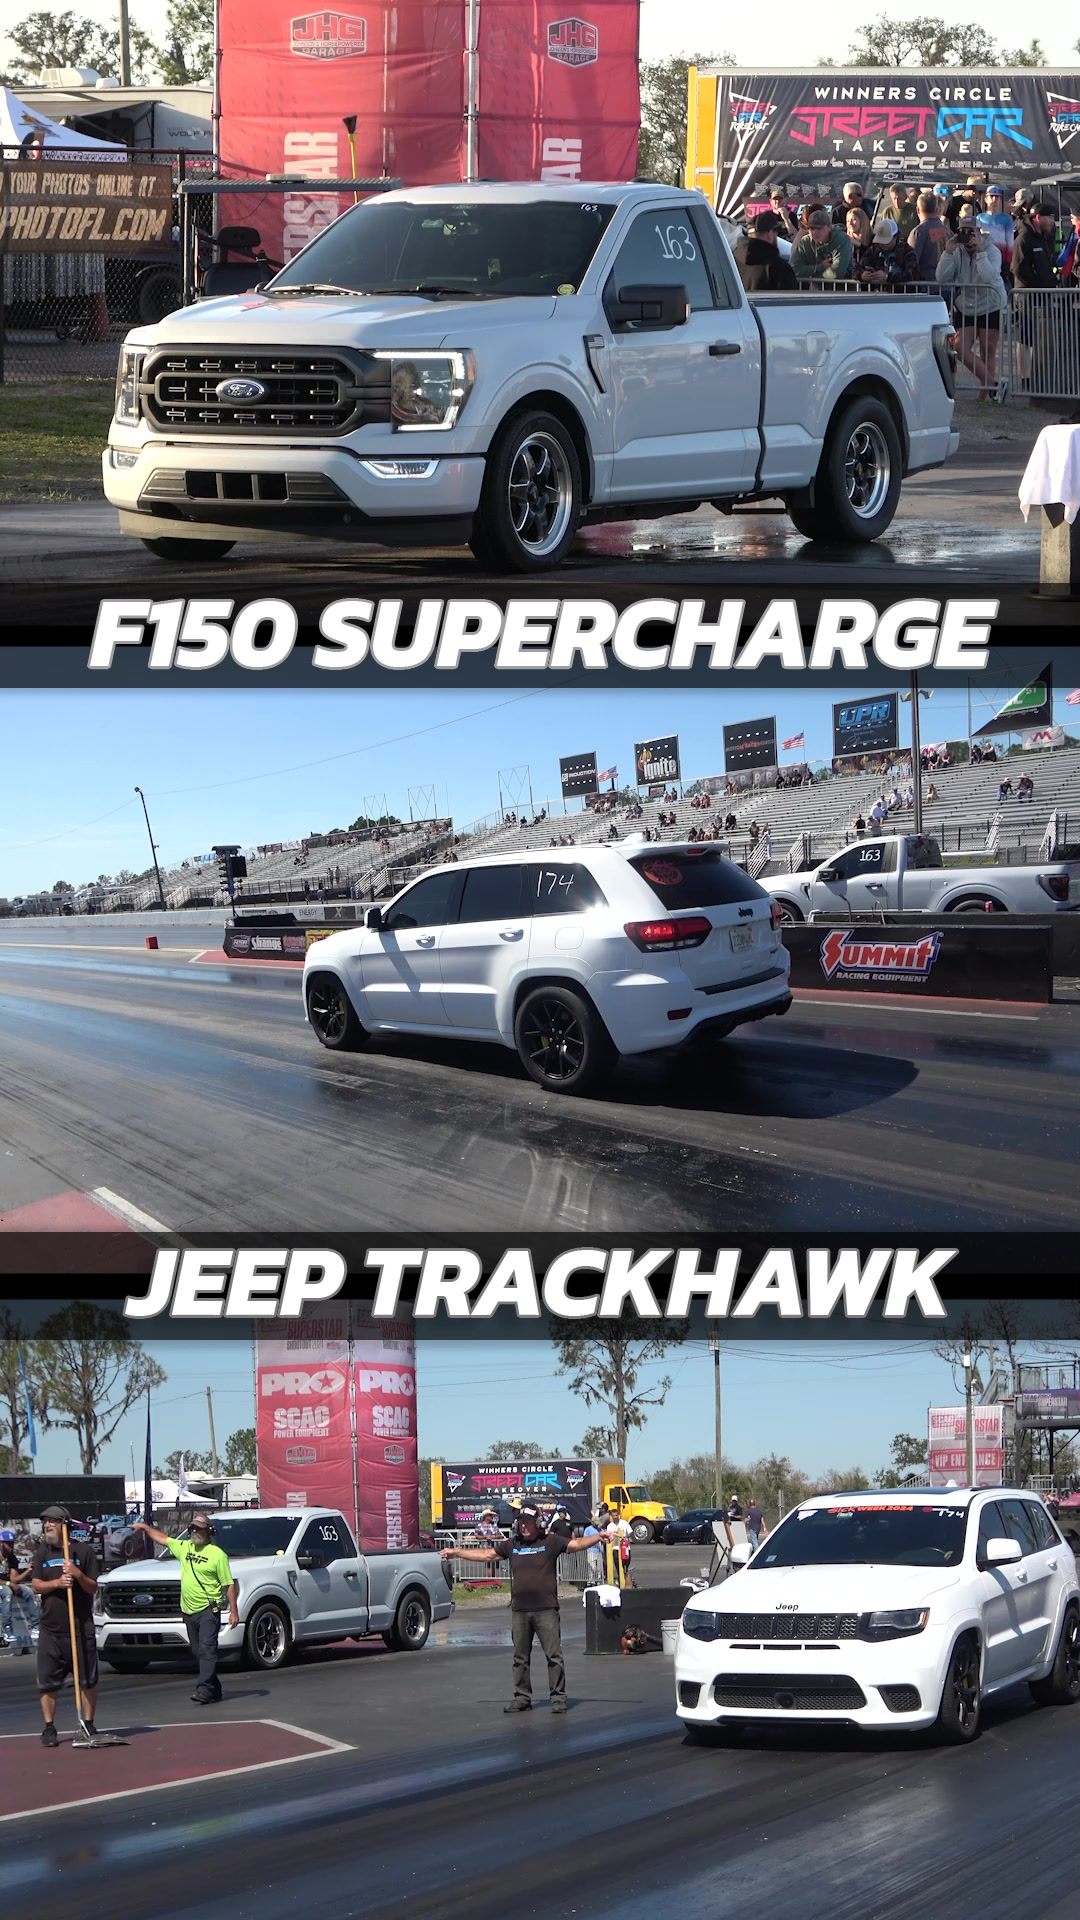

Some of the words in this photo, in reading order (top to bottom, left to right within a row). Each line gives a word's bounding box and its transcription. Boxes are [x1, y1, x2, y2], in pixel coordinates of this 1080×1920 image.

[293, 14, 363, 41] JHG
[549, 22, 596, 49] JHG
[302, 47, 353, 57] GARAGE
[556, 53, 591, 63] GARAGE
[814, 86, 917, 101] WINNERS
[929, 87, 1012, 101] CIRCLE
[789, 105, 936, 147] STREET
[936, 107, 1033, 150] CAR
[832, 139, 993, 154] TAKEOVER
[10, 172, 38, 194] YOUR
[41, 172, 91, 196] PHOTOS
[96, 175, 134, 197] ONLINE
[138, 176, 157, 197] AT
[580, 203, 598, 212] 163
[654, 225, 697, 262] 163
[227, 383, 254, 397] Ford
[840, 702, 890, 726] UPR
[568, 769, 596, 778] INDUCTION
[643, 758, 678, 781] ignite
[859, 849, 881, 862] 163
[536, 870, 574, 897] 174
[738, 907, 754, 918] Jeep
[251, 935, 282, 951] Strange
[836, 972, 870, 980] RACING
[871, 974, 929, 983] EQUIPMENT
[287, 1319, 343, 1339] SUPERSTAR
[286, 1340, 311, 1351] SHOOTOUT
[261, 1370, 346, 1397] PRO
[359, 1369, 415, 1397] PRO
[273, 1405, 330, 1429] SCAG
[372, 1405, 410, 1428] SCAG
[273, 1430, 294, 1439] POWER
[295, 1427, 330, 1438] EQUIPMENT
[372, 1427, 389, 1437] POWER
[935, 1456, 949, 1467] VIP
[470, 1474, 525, 1492] STREET
[524, 1473, 563, 1490] CAR
[486, 1486, 548, 1494] TAKEOVER
[319, 1526, 339, 1542] 163
[775, 1602, 799, 1612] Jeep
